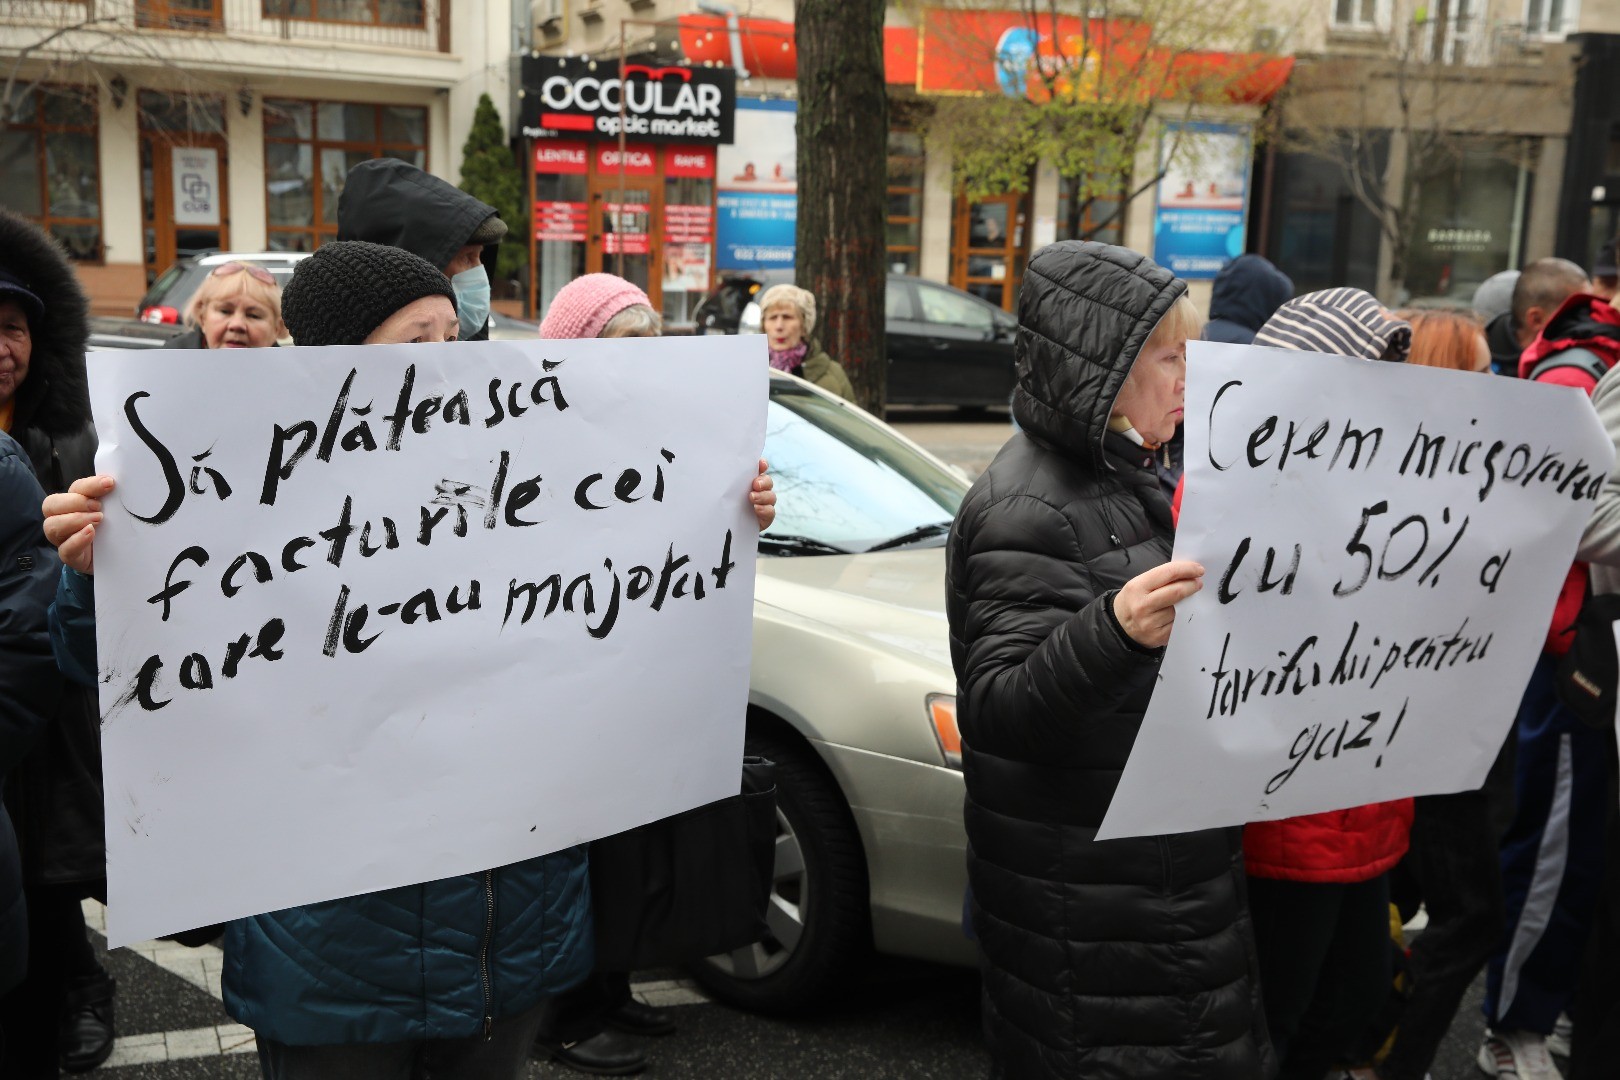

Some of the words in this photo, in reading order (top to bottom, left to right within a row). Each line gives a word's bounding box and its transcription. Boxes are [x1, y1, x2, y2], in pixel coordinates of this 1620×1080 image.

[541, 75, 722, 117] OCCULAR
[597, 114, 649, 136] optic
[651, 117, 721, 138] market
[537, 149, 586, 163] LENTILE
[601, 151, 652, 167] OPTICA
[123, 391, 232, 525] Să
[259, 359, 570, 505] plătească
[1208, 380, 1384, 471] Cerem
[147, 450, 542, 621] facturile
[574, 447, 676, 510] cei
[1218, 537, 1301, 604] cu
[1333, 501, 1469, 598] 50%
[1480, 549, 1511, 593] a
[137, 617, 286, 711] care
[322, 579, 482, 658] le-au
[502, 530, 735, 640] majorat
[1207, 621, 1380, 720] tarifului
[1370, 617, 1493, 689] pentru
[1265, 697, 1408, 794] gaz!
